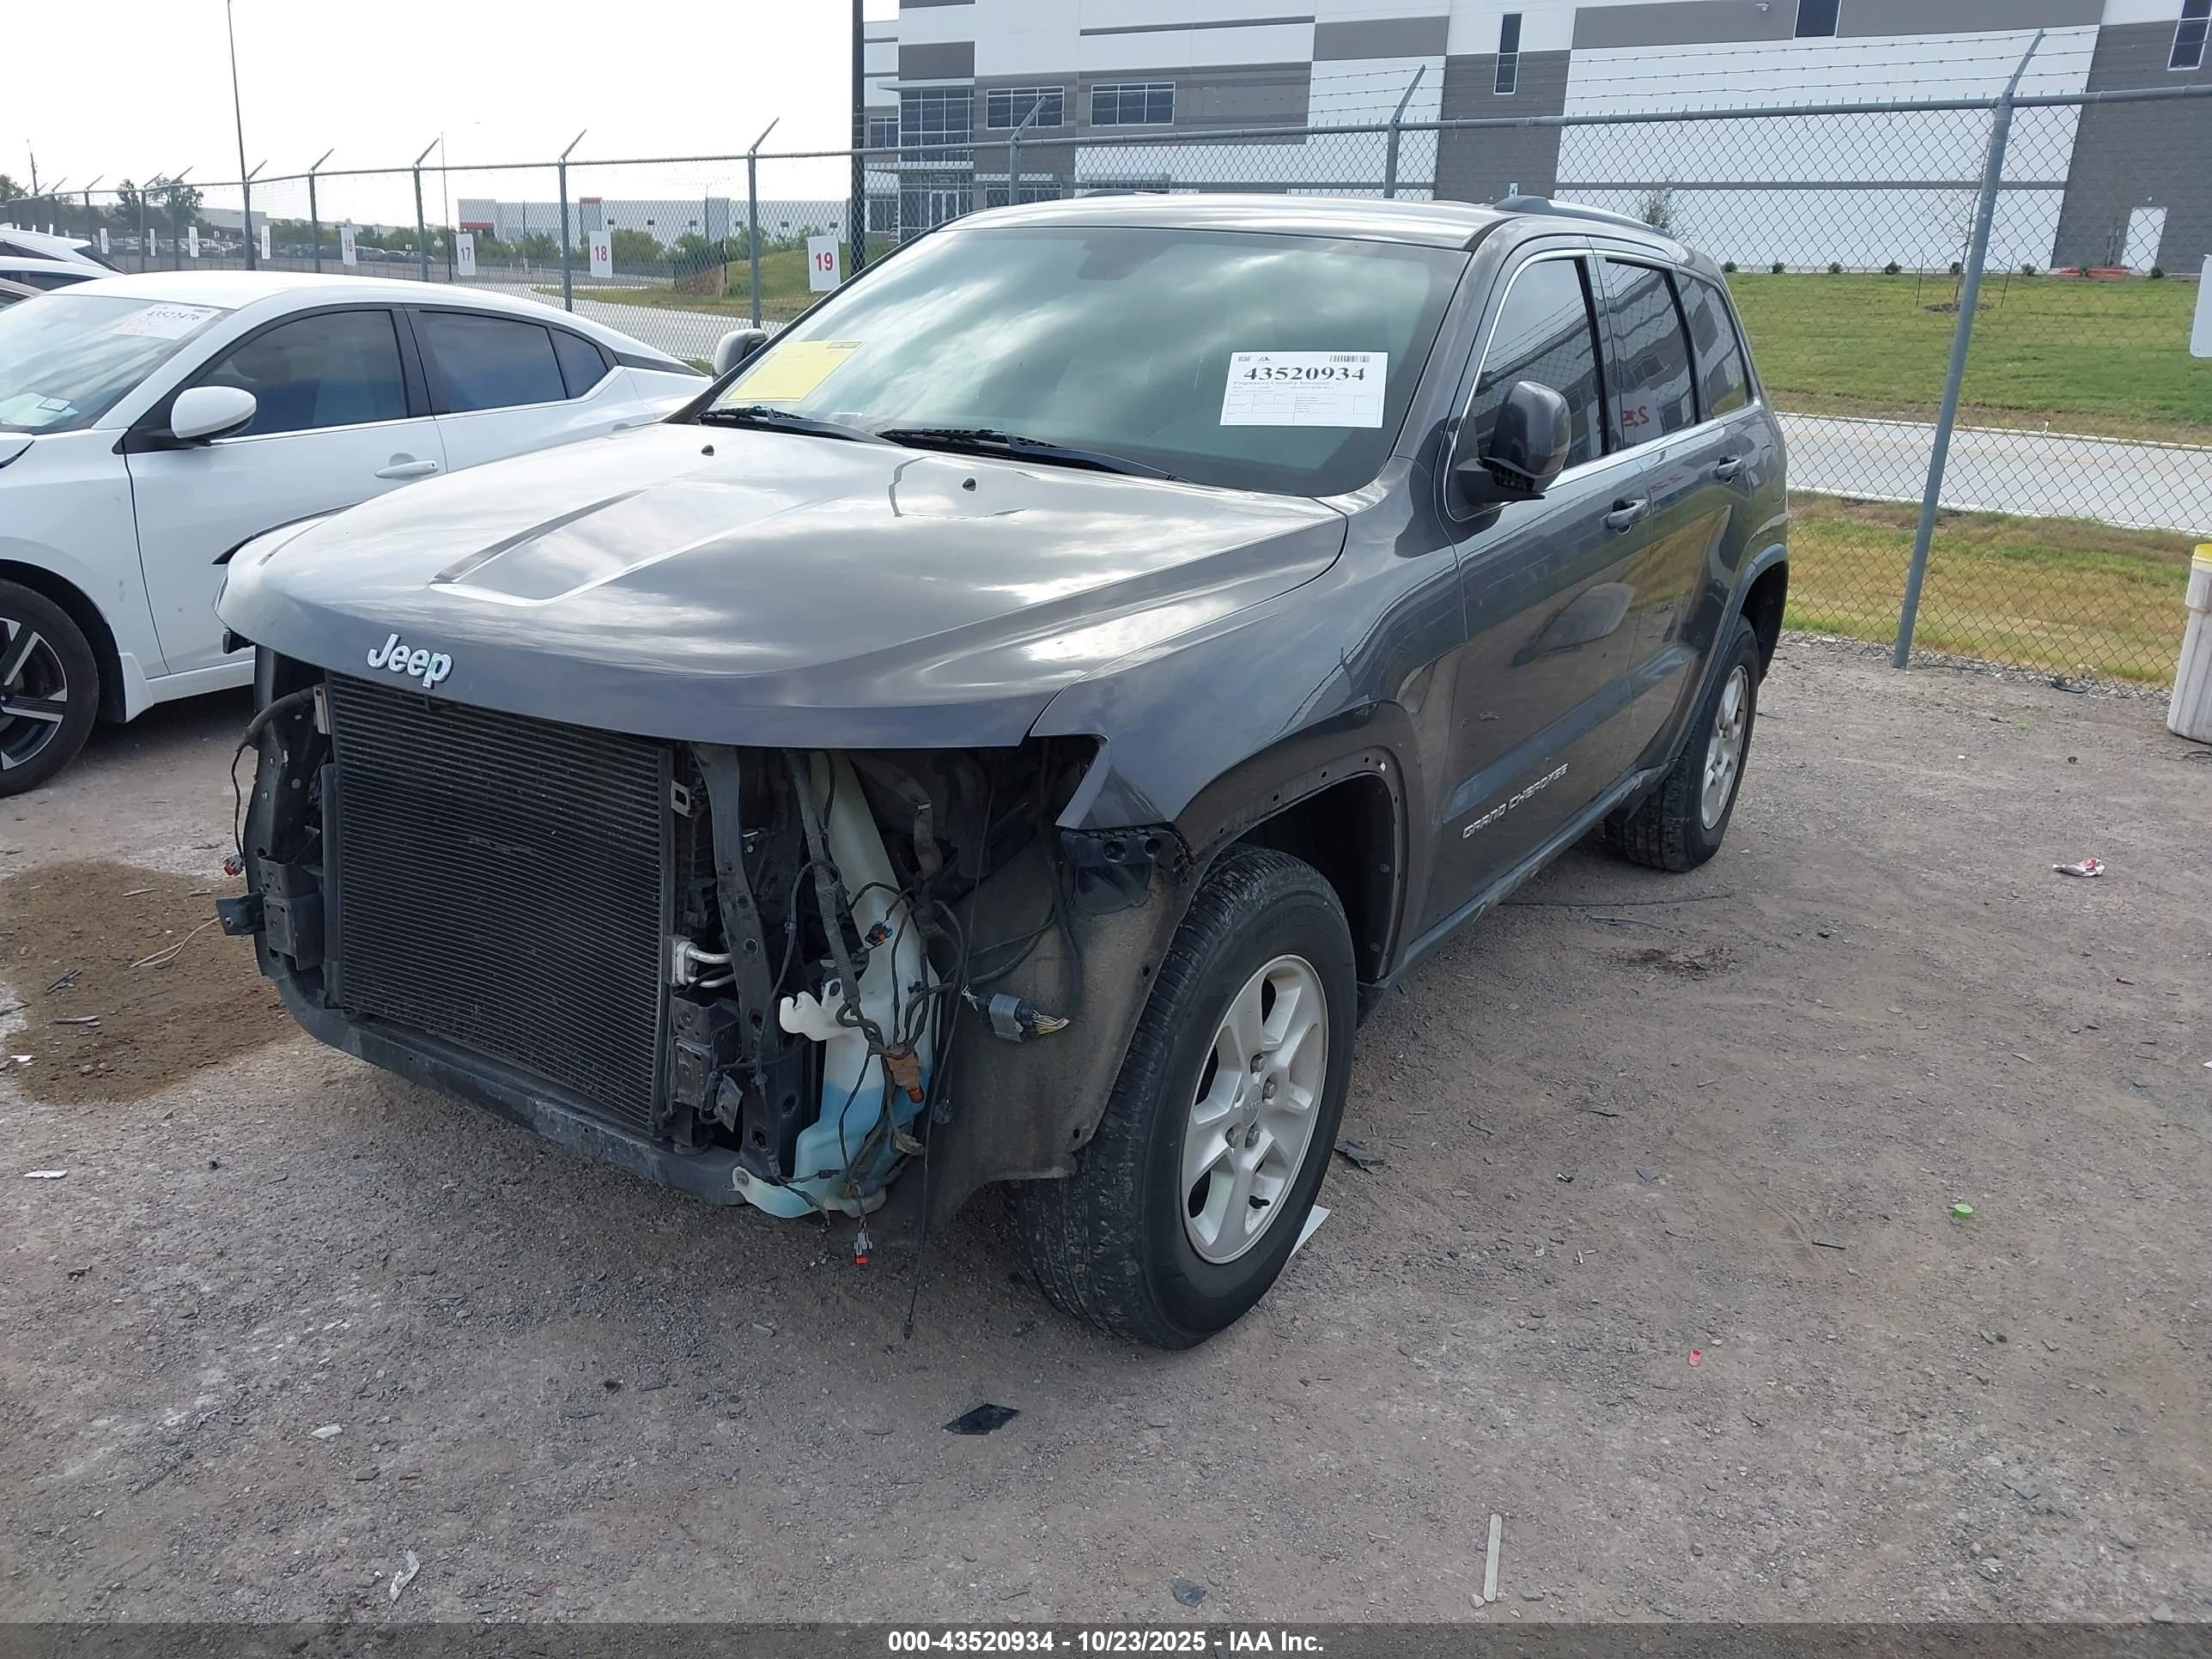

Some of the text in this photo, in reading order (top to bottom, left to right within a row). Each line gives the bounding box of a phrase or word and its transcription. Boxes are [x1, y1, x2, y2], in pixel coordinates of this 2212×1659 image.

[344, 240, 354, 252] 16
[461, 246, 471, 261] 17
[595, 246, 608, 262] 18
[815, 252, 833, 271] 19
[1243, 367, 1365, 380] 43520934
[367, 633, 453, 690] Jeep
[1462, 763, 1569, 839] GRAND CHEROKEE
